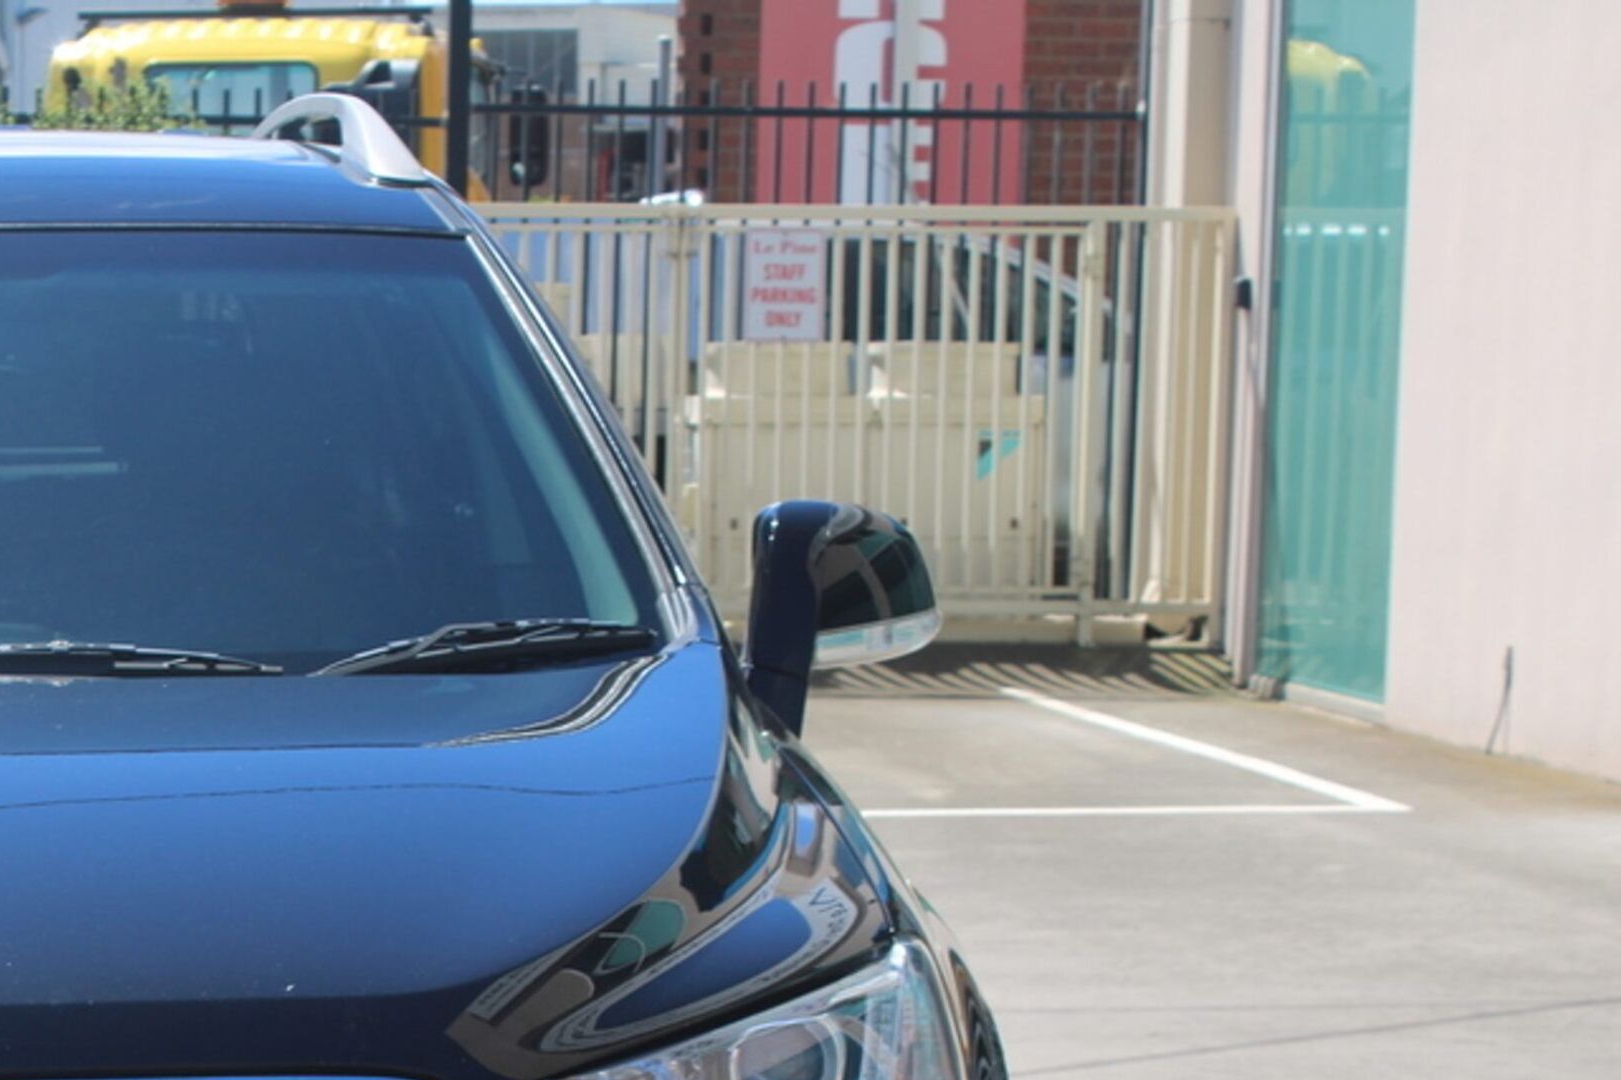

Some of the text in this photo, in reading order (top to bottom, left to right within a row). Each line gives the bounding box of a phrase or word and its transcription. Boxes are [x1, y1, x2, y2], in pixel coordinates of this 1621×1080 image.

[762, 263, 807, 281] STAFF
[749, 285, 817, 304] PARKING
[763, 309, 803, 328] ONLY
